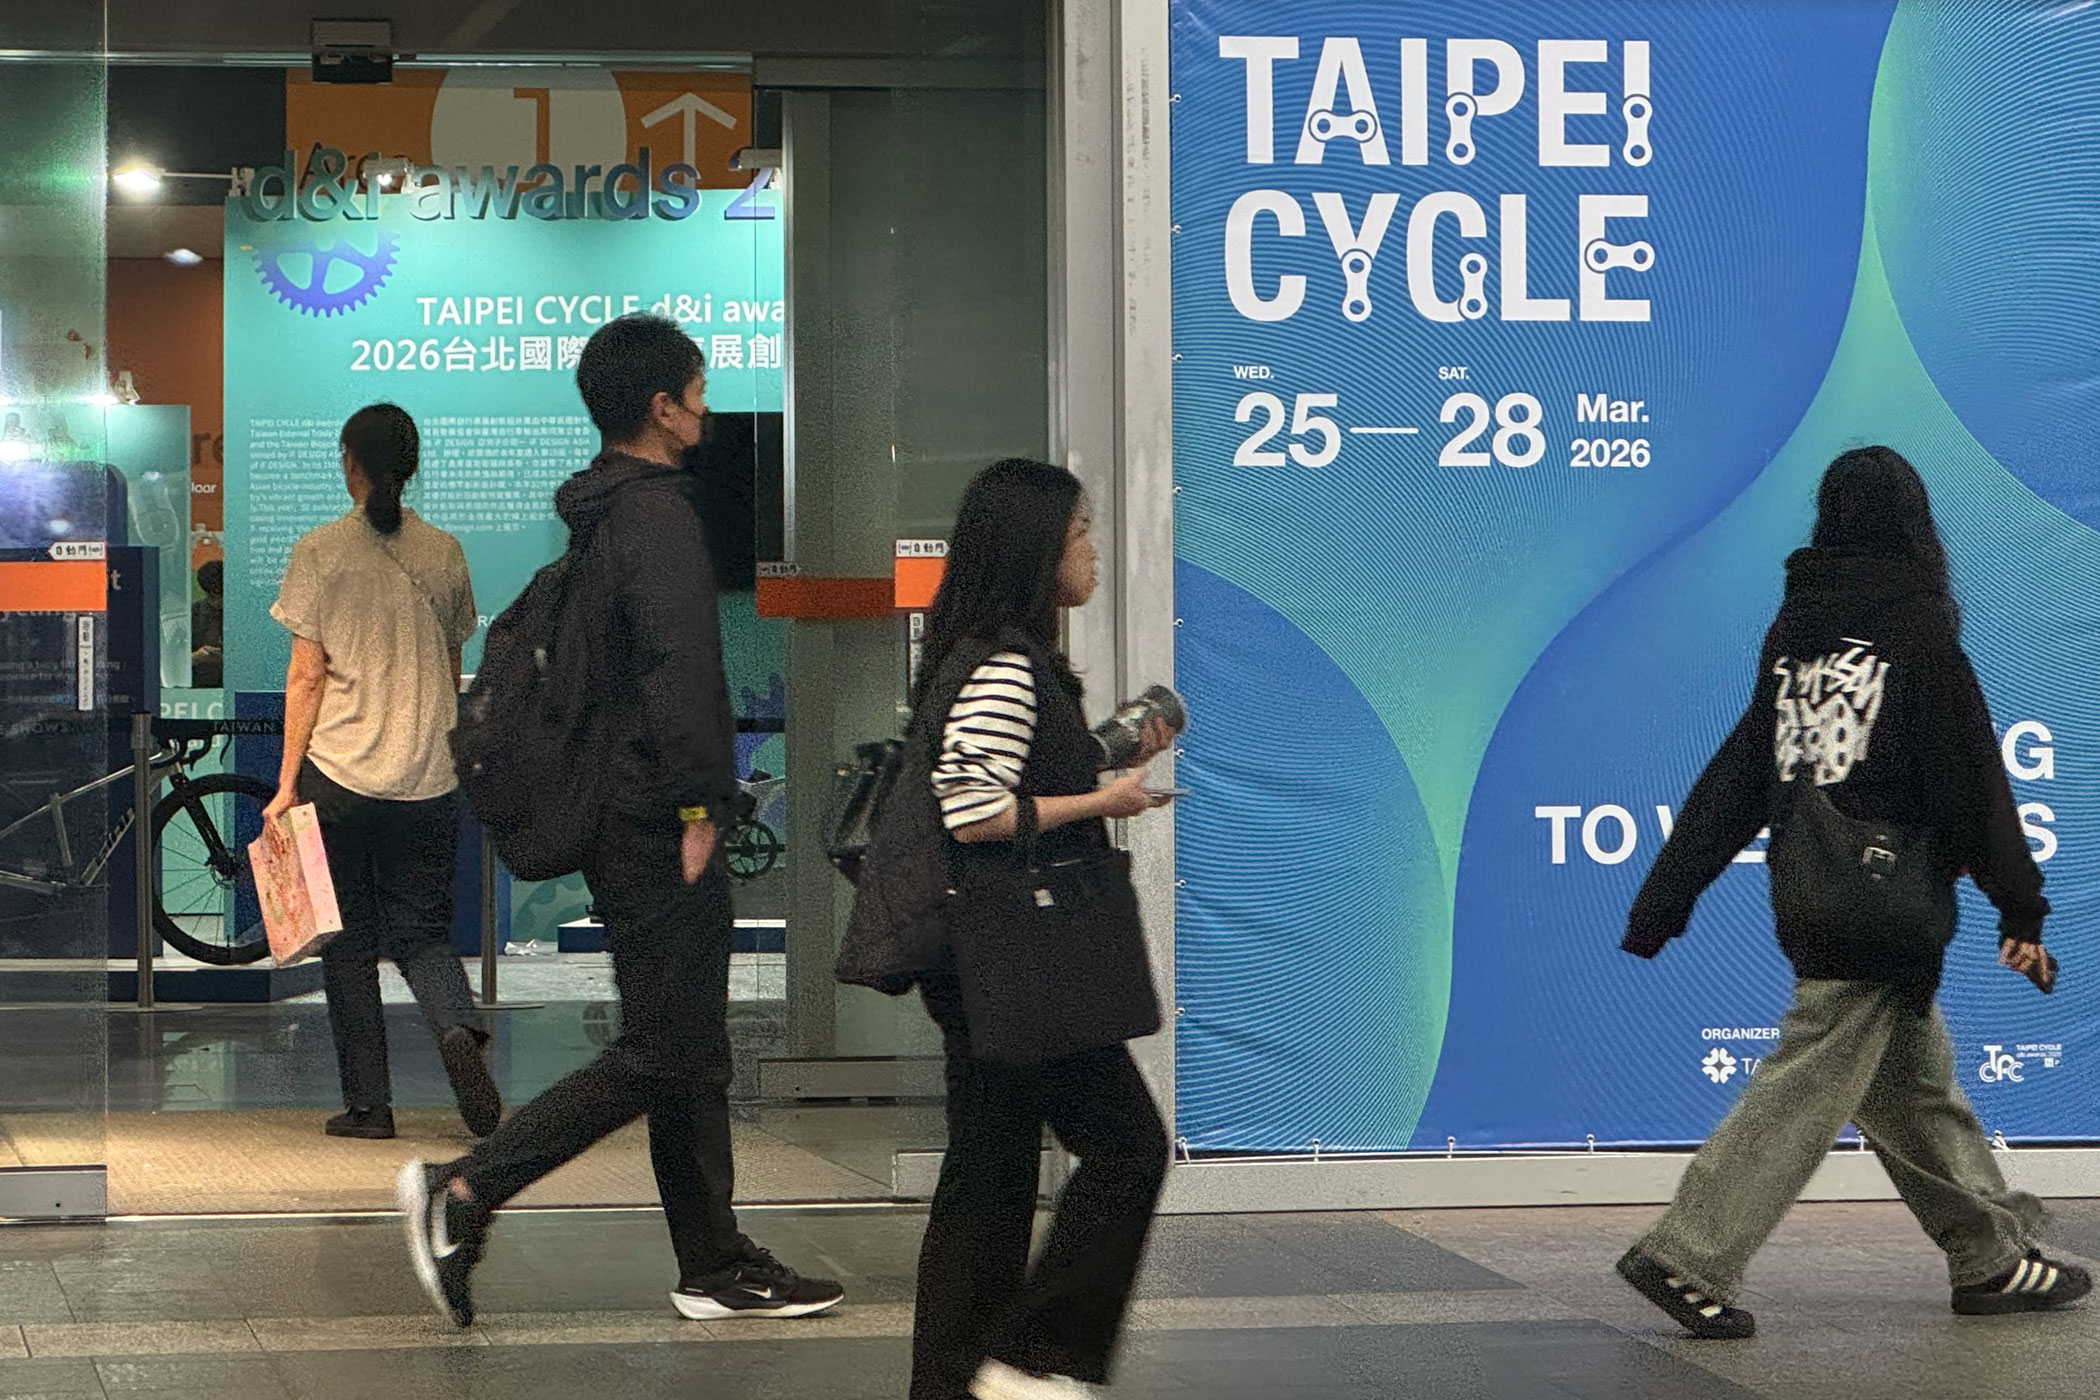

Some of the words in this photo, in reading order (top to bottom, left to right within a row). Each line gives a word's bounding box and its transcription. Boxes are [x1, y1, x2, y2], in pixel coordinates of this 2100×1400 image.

[1219, 35, 1653, 167] TAIPEI
[409, 147, 702, 220] awards
[1225, 189, 1655, 323] CYCLE
[417, 295, 523, 326] TAIPEI
[535, 295, 639, 324] CYCLE
[650, 293, 712, 323] d&i
[350, 333, 782, 372] 2026台北國際展創
[1234, 366, 1274, 379] WED.
[1438, 366, 1470, 380] SAT.
[1233, 391, 1342, 468] 25
[1438, 391, 1546, 468] 28
[1577, 393, 1649, 423] Mar.
[1570, 438, 1651, 468] 2026
[213, 721, 274, 734] TAIWAN
[1535, 804, 1638, 865] TO
[1702, 1028, 1780, 1040] ORGANIZER
